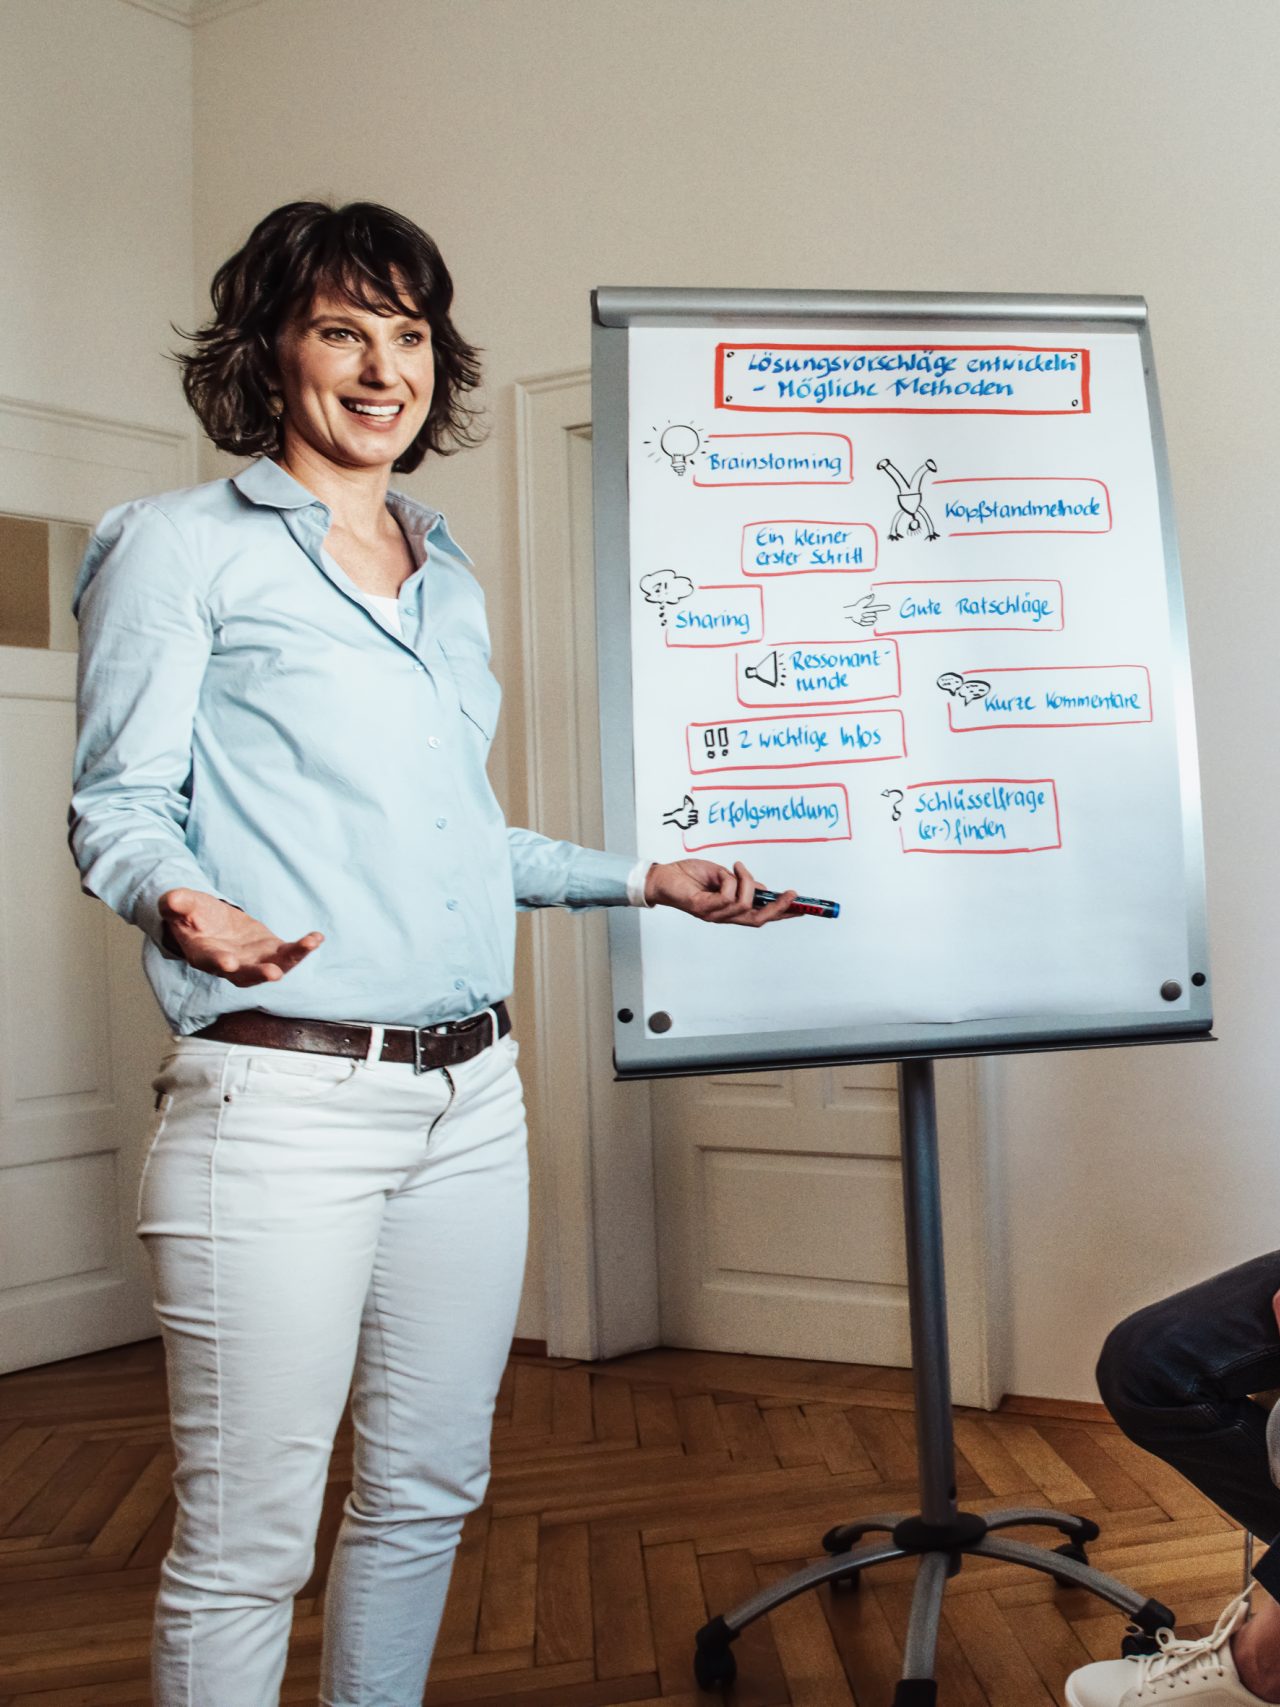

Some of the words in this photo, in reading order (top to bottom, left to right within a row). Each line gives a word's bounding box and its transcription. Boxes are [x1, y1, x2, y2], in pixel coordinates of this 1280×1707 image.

[747, 350, 957, 379] Lösungsvorschläge
[966, 353, 1078, 374] entwickeln
[777, 376, 878, 404] Mögliche
[887, 376, 1015, 398] Methoden
[707, 452, 843, 477] Brainstorming
[755, 527, 785, 546] Ein
[794, 528, 851, 545] kleiner
[755, 549, 802, 567] erster
[808, 546, 864, 567] Schritt
[899, 597, 942, 619] Gute
[955, 591, 1054, 622] Ratschläge
[674, 610, 750, 635] Sharing
[795, 671, 849, 692] runde
[738, 729, 752, 750] 2
[758, 727, 829, 753] wichtige
[840, 723, 882, 750] Infos
[707, 795, 840, 829] Erfolgsmeldung
[914, 786, 1046, 814] Schlüsselfrage
